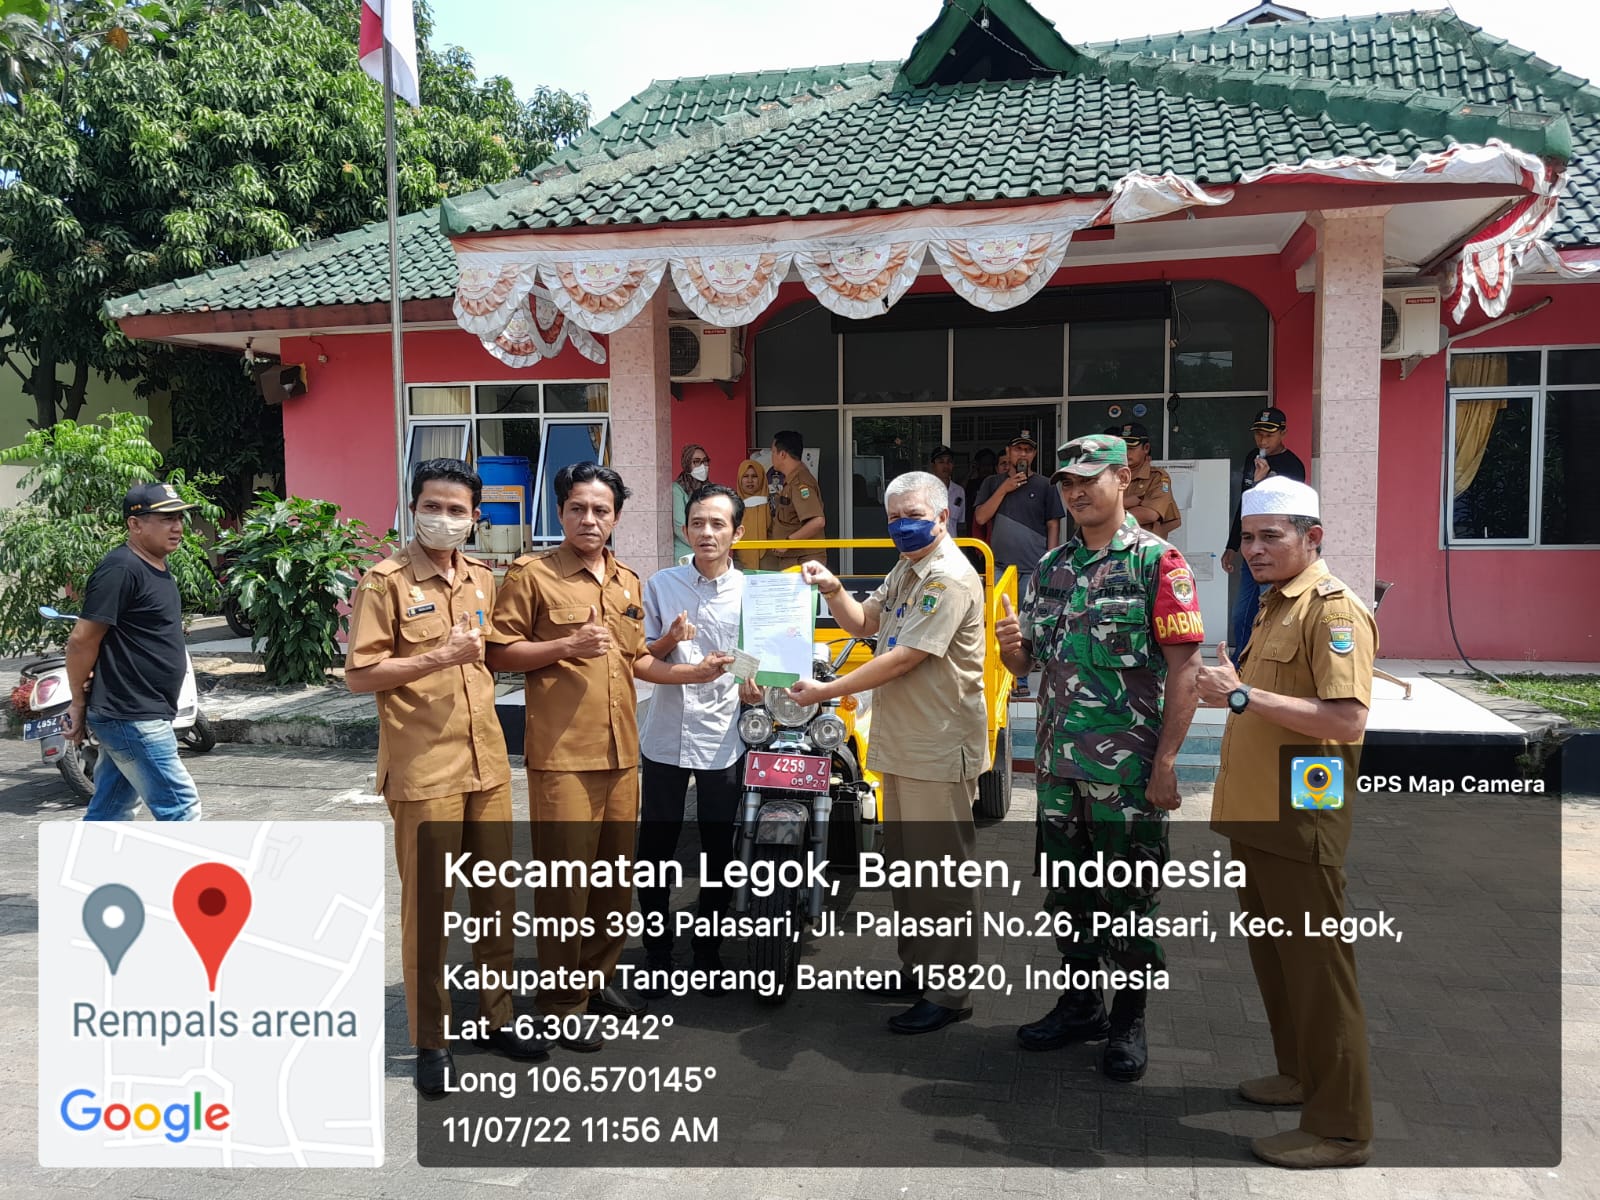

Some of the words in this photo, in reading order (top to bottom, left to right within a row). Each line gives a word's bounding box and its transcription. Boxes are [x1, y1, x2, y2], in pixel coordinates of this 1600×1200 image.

[752, 756, 760, 770] A
[773, 758, 806, 773] 4259
[817, 761, 826, 775] Z
